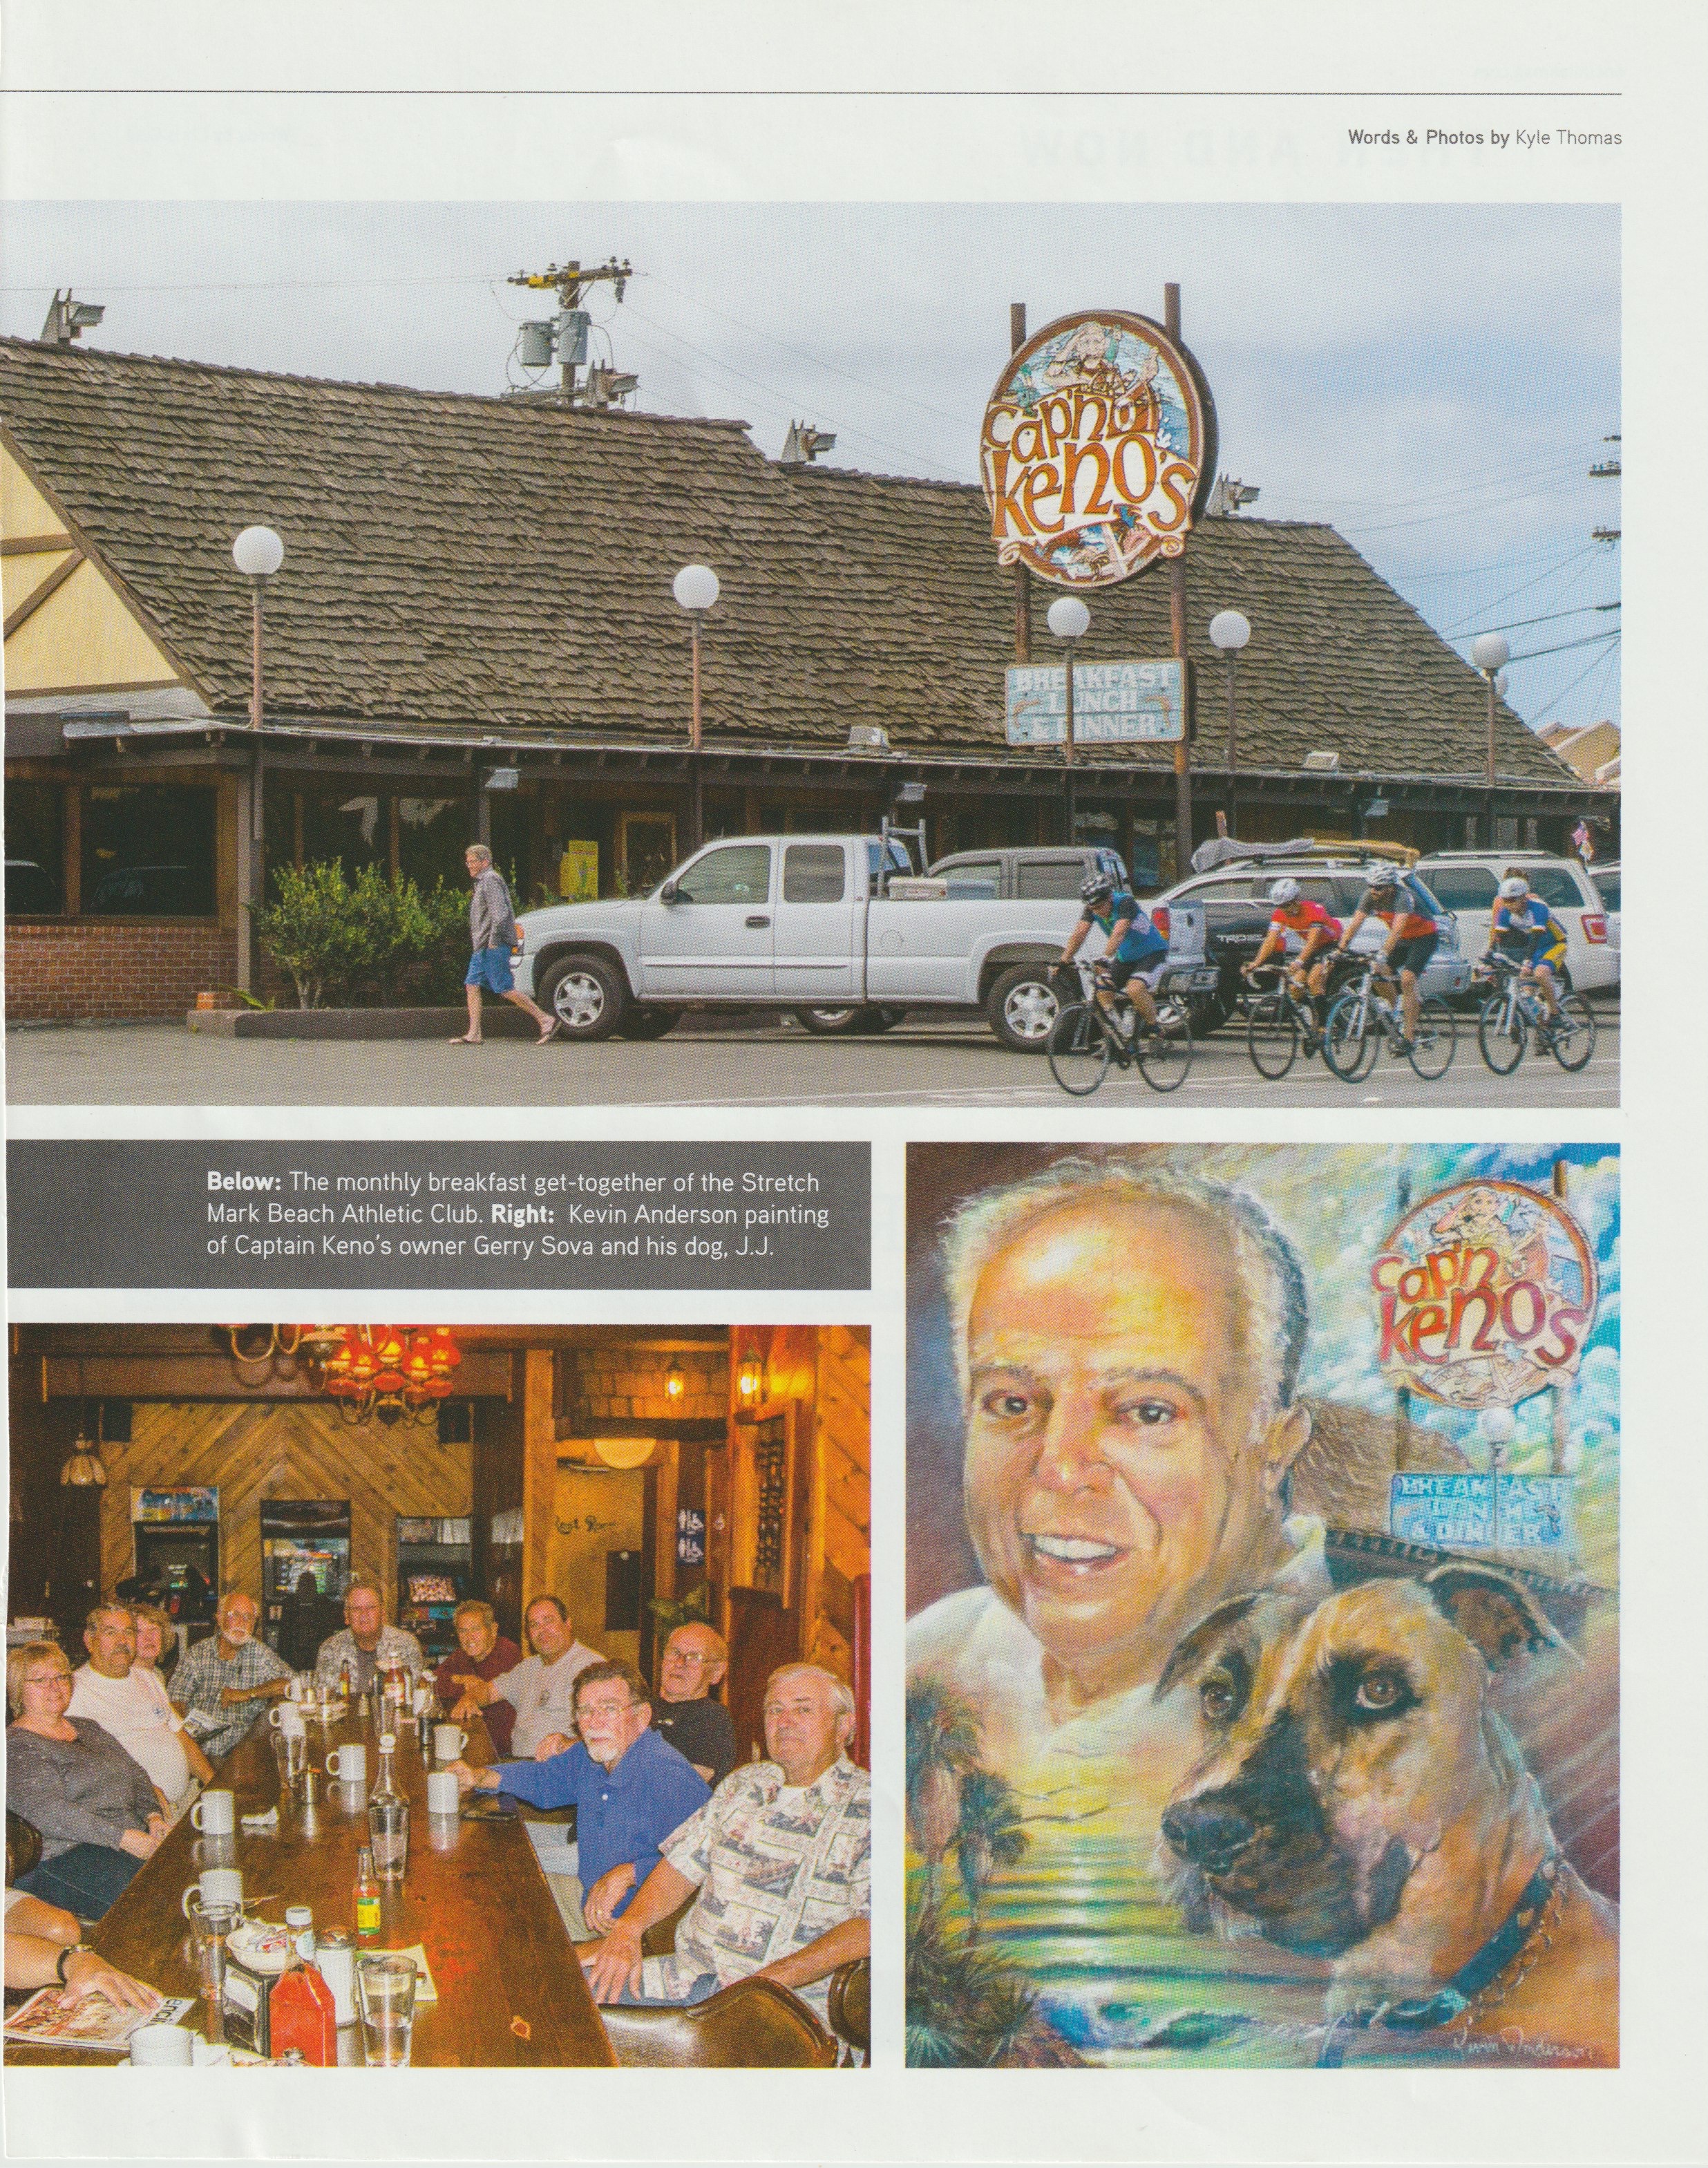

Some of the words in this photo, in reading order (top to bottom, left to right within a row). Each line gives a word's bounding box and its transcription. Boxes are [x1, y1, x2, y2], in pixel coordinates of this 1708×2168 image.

[1348, 129, 1401, 144] Words
[1406, 129, 1418, 144] &
[1426, 129, 1484, 144] Photos
[1491, 129, 1510, 149] by
[1516, 129, 1550, 149] Kyle
[1556, 129, 1622, 144] Thomas
[207, 1171, 281, 1191] Below:
[290, 1171, 329, 1191] The
[337, 1172, 421, 1196] monthly
[429, 1172, 526, 1191] breakfast
[534, 1172, 666, 1196] get-together
[674, 1172, 694, 1191] of
[701, 1172, 734, 1192] the
[742, 1172, 819, 1192] Stretch
[208, 1203, 259, 1223] Mark
[268, 1203, 334, 1223] Beach
[342, 1204, 422, 1223] Athletic
[430, 1203, 484, 1223] Club.
[491, 1203, 554, 1228] Right:
[570, 1204, 627, 1223] Kevin
[634, 1204, 737, 1223] Anderson
[746, 1204, 829, 1229] painting
[207, 1235, 227, 1254] of
[235, 1234, 314, 1259] Captain
[323, 1234, 392, 1254] Keno's
[399, 1241, 466, 1255] owner
[474, 1235, 534, 1261] Gerry
[542, 1235, 593, 1255] Sova
[601, 1236, 638, 1255] and
[647, 1236, 677, 1255] his
[685, 1236, 728, 1260] dog,
[735, 1236, 775, 1256] J.J.
